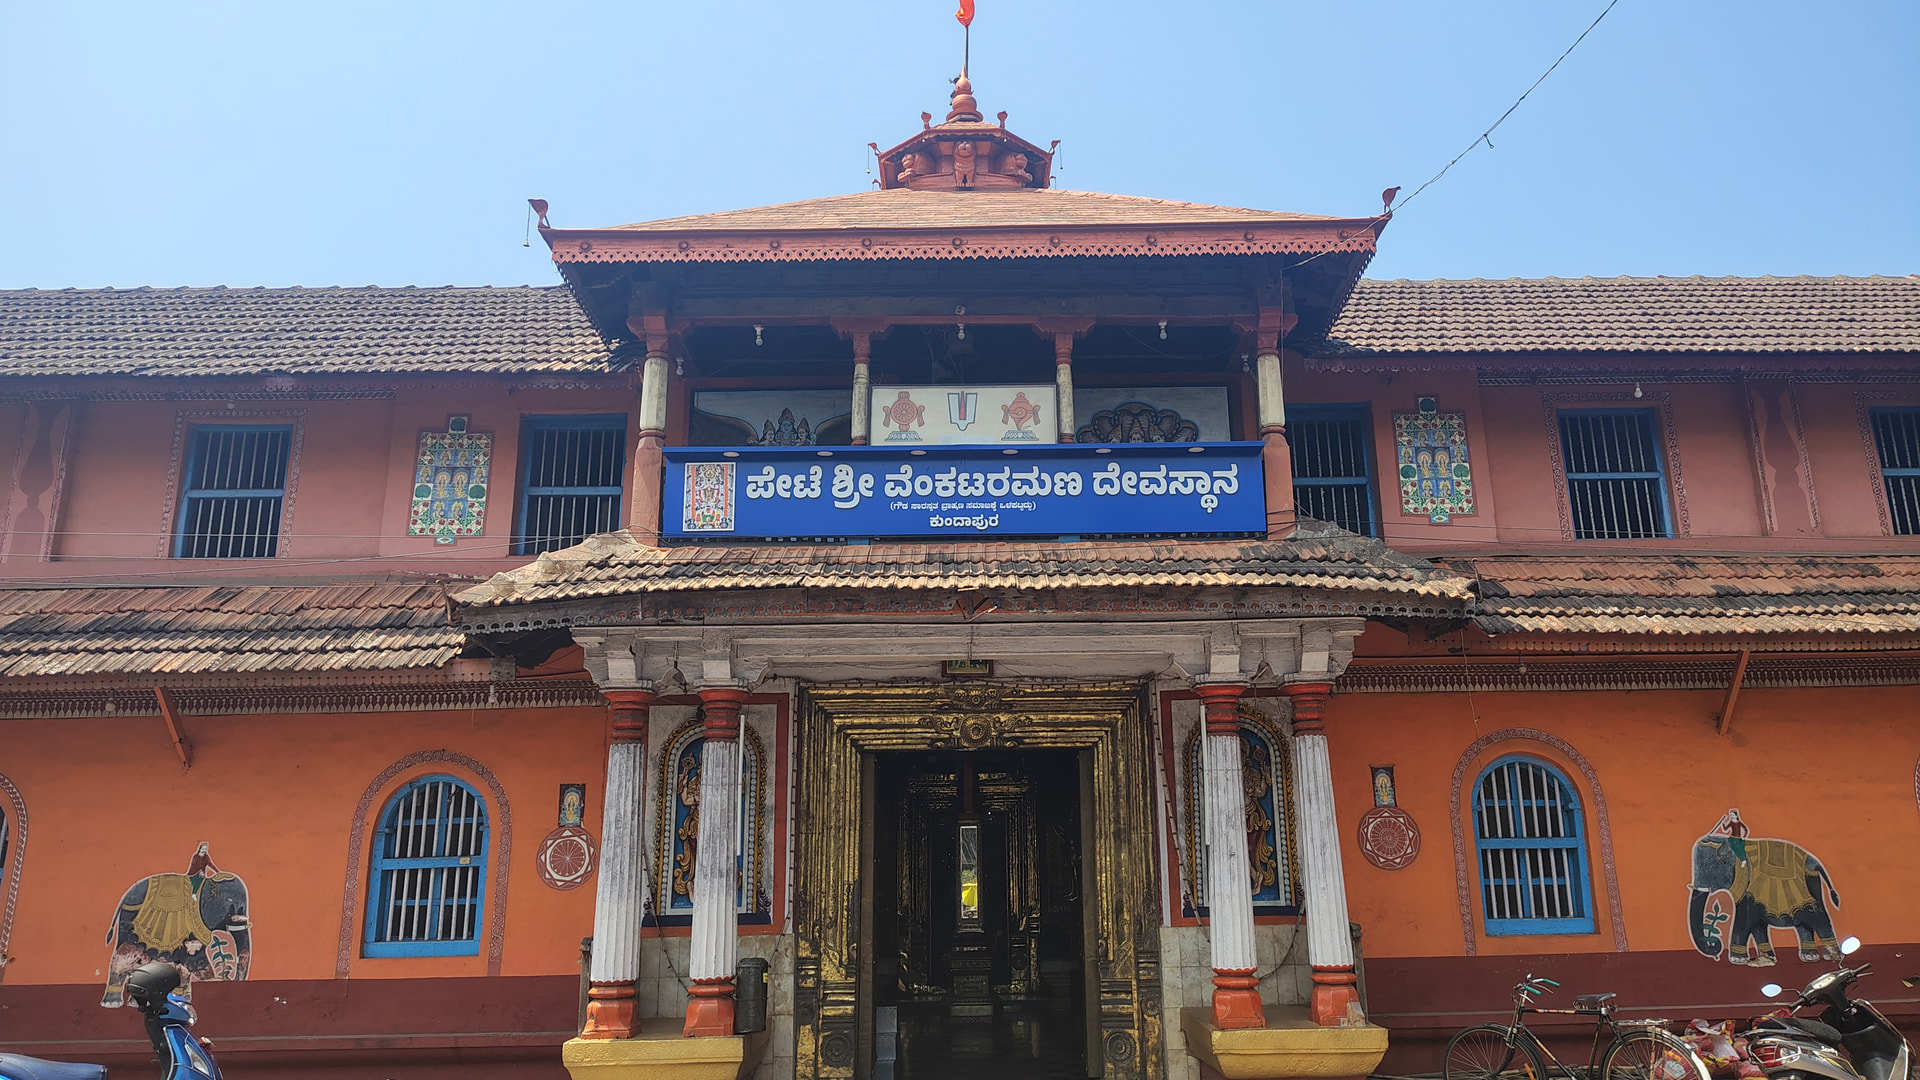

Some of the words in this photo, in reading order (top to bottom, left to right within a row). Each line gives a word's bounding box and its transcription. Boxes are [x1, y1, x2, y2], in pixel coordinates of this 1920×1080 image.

[746, 465, 823, 500] ಪೇಟೆ
[831, 464, 875, 509] ಶ್ರೀ
[884, 464, 1083, 498] ವೆಂಕಟರಮಣ
[1092, 462, 1239, 514] ದೇವಸ್ಥಾನ
[929, 513, 999, 530] ಕುಂದಾಪುರ
